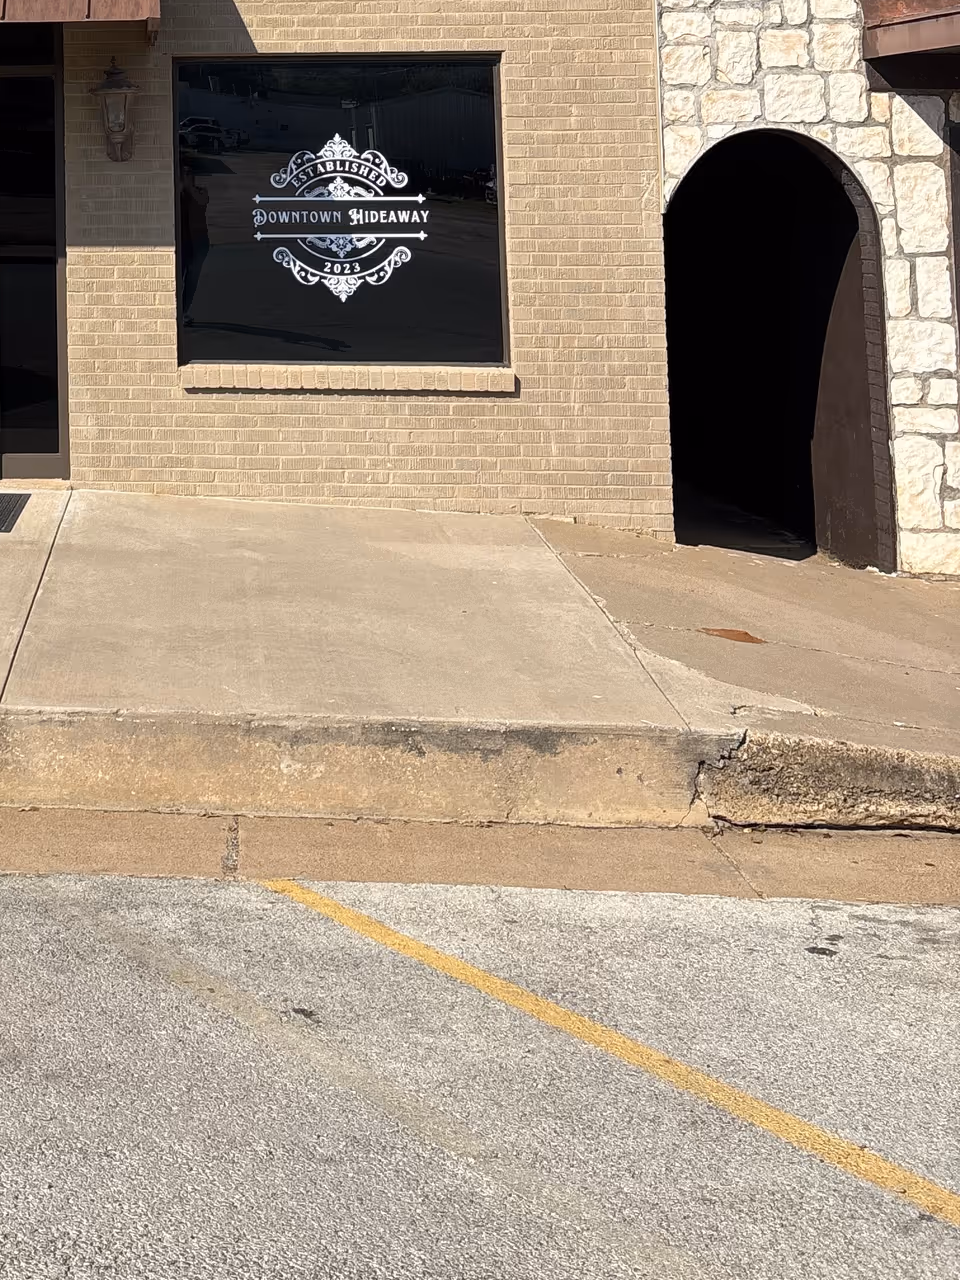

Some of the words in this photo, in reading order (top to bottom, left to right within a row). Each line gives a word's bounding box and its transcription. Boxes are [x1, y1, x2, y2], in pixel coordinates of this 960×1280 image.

[291, 161, 387, 188] ESTABLISHED
[252, 208, 342, 228] DOWNTOWN
[348, 208, 430, 226] HIDEAWAY
[323, 262, 361, 274] 2023
